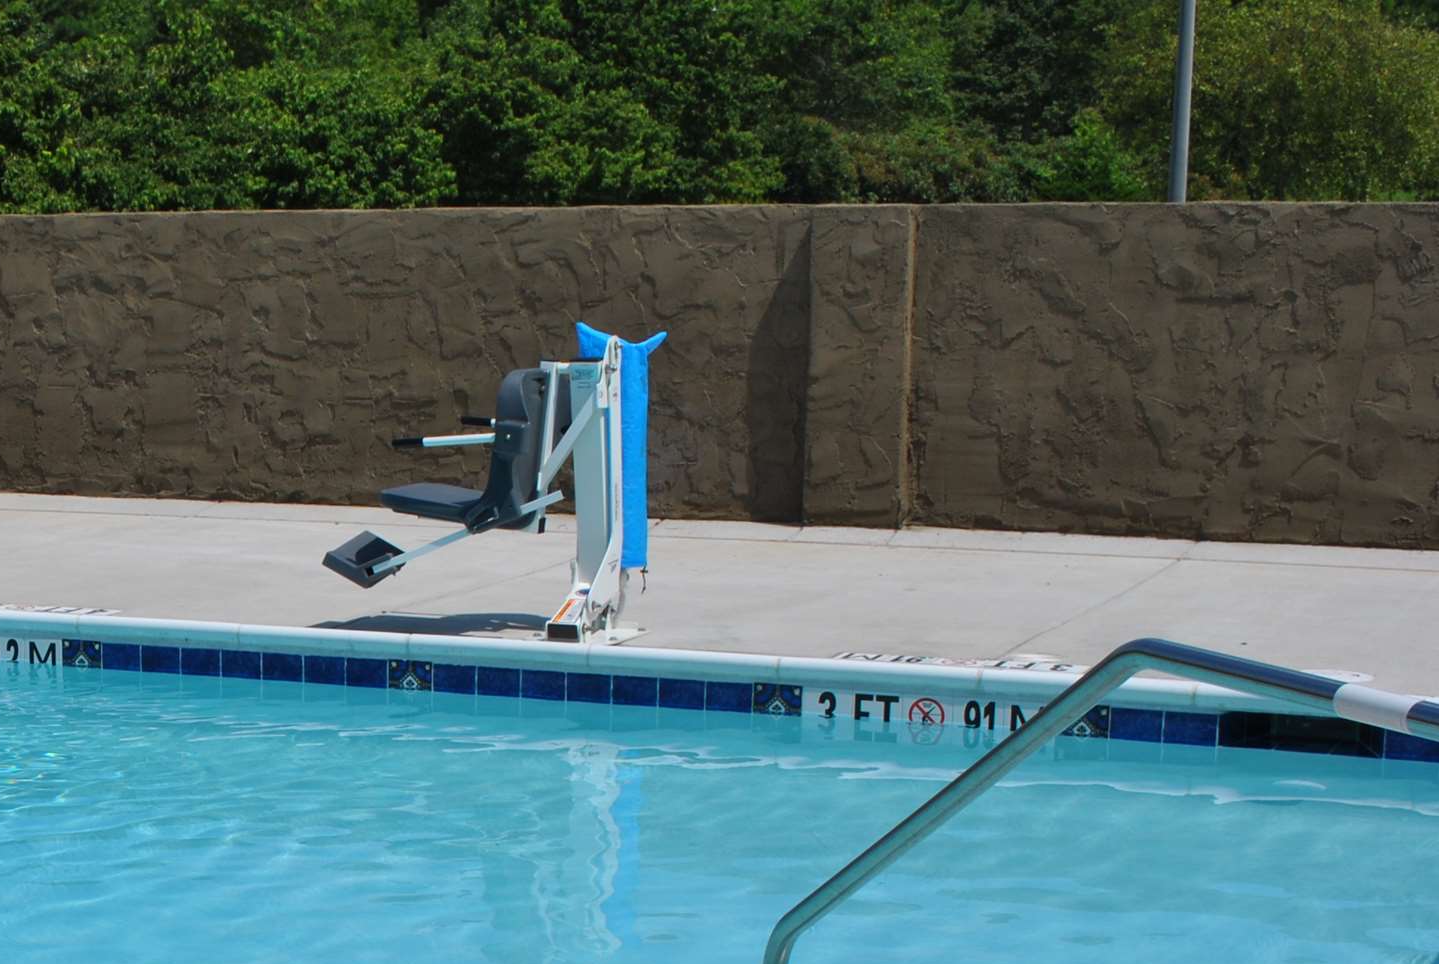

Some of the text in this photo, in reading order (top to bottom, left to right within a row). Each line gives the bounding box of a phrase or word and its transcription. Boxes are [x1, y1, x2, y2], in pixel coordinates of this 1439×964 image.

[29, 641, 57, 666] M
[817, 691, 837, 719] 3
[854, 693, 900, 722] FT
